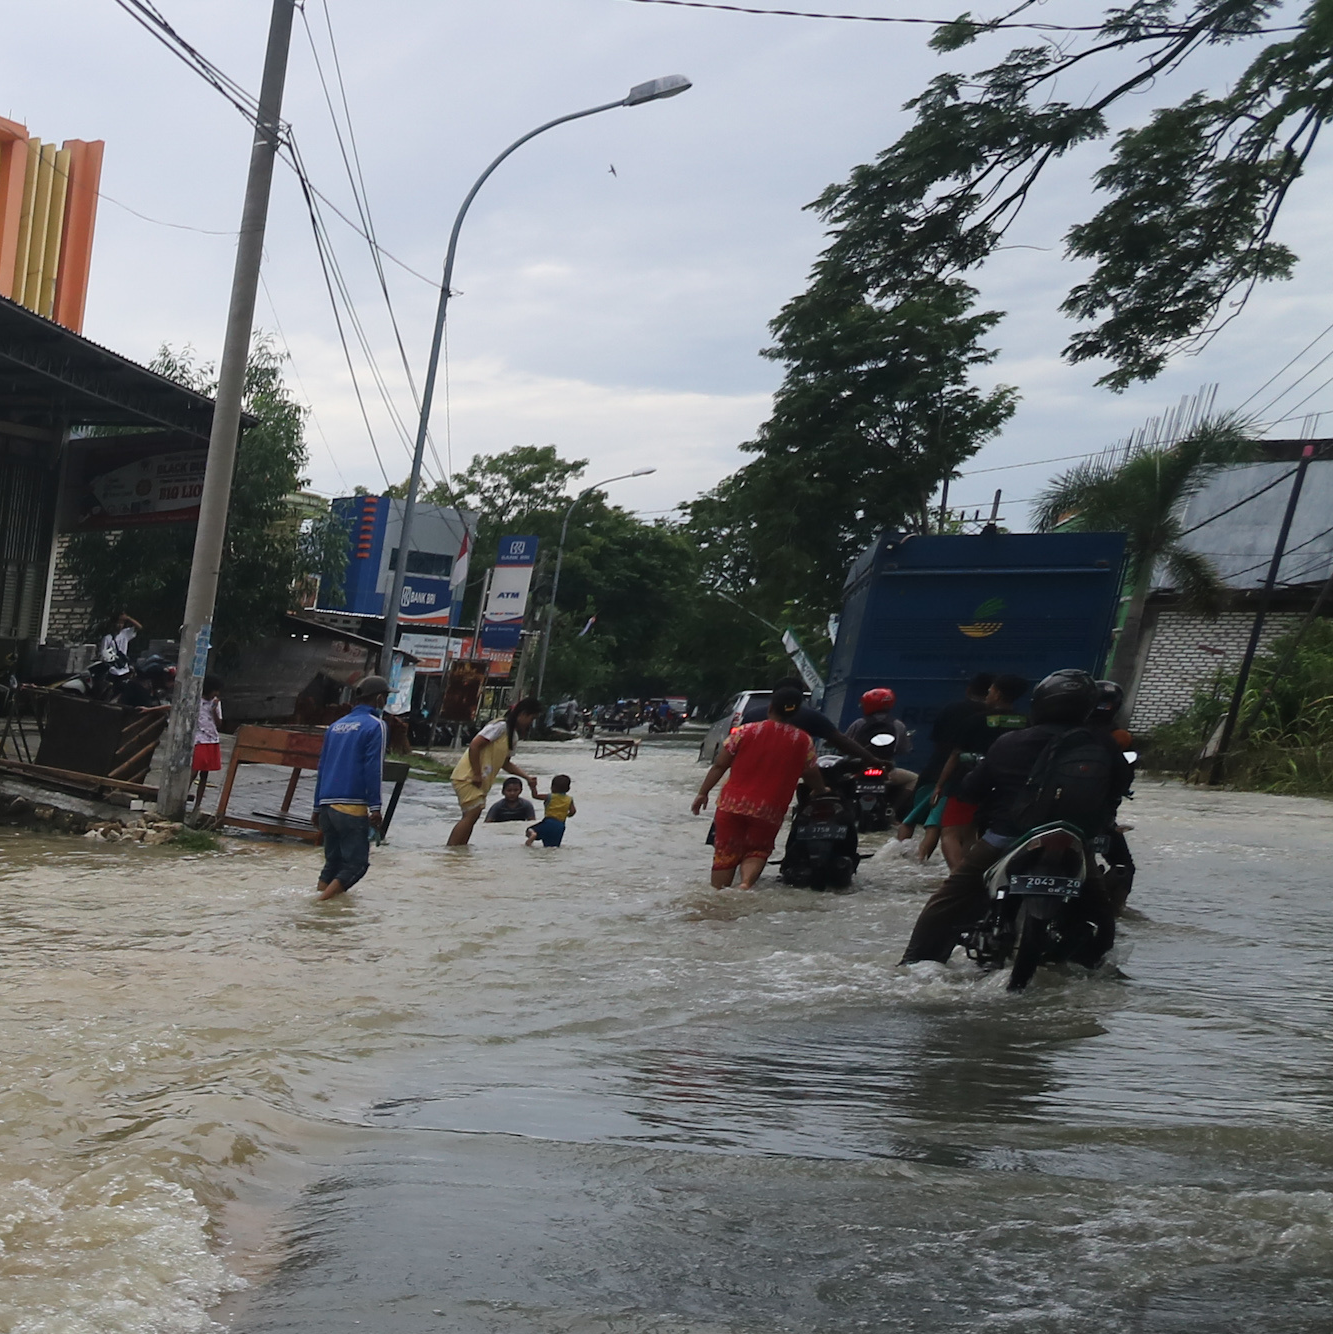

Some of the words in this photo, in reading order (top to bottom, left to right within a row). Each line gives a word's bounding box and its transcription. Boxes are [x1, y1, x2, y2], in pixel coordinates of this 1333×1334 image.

[157, 462, 188, 475] BLACK
[159, 486, 179, 500] BIG
[181, 484, 203, 498] LIO
[410, 591, 425, 604] BANK
[426, 593, 435, 604] BRI
[1027, 878, 1055, 886] 2043
